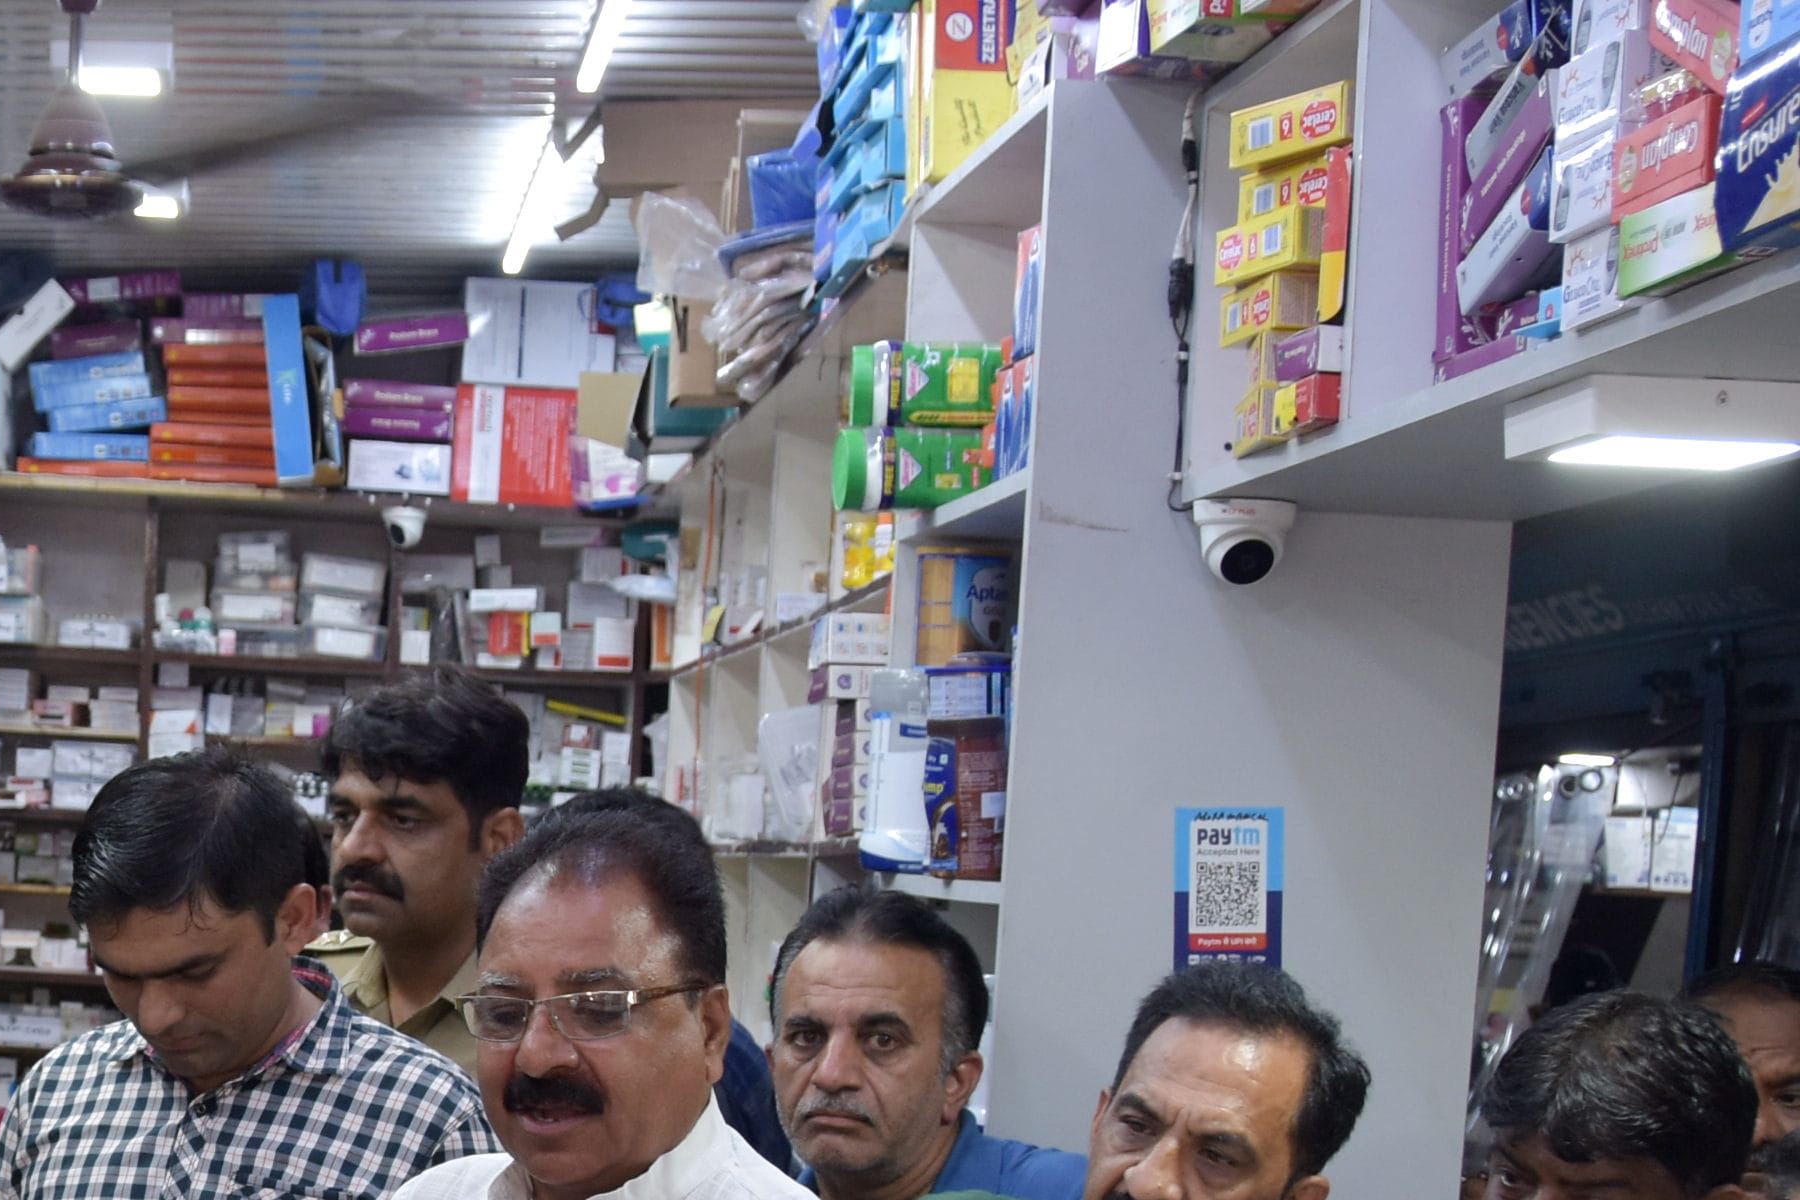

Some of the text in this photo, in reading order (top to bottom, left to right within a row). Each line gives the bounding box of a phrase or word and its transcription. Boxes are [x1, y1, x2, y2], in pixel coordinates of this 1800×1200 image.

[1655, 0, 1709, 61] Complan
[1302, 108, 1337, 128] Cerelac
[1736, 92, 1800, 174] Ensure
[1641, 120, 1698, 175] Complan
[965, 584, 1006, 604] Apta
[1197, 827, 1260, 845] paytm
[1196, 847, 1260, 857] Accepted Here
